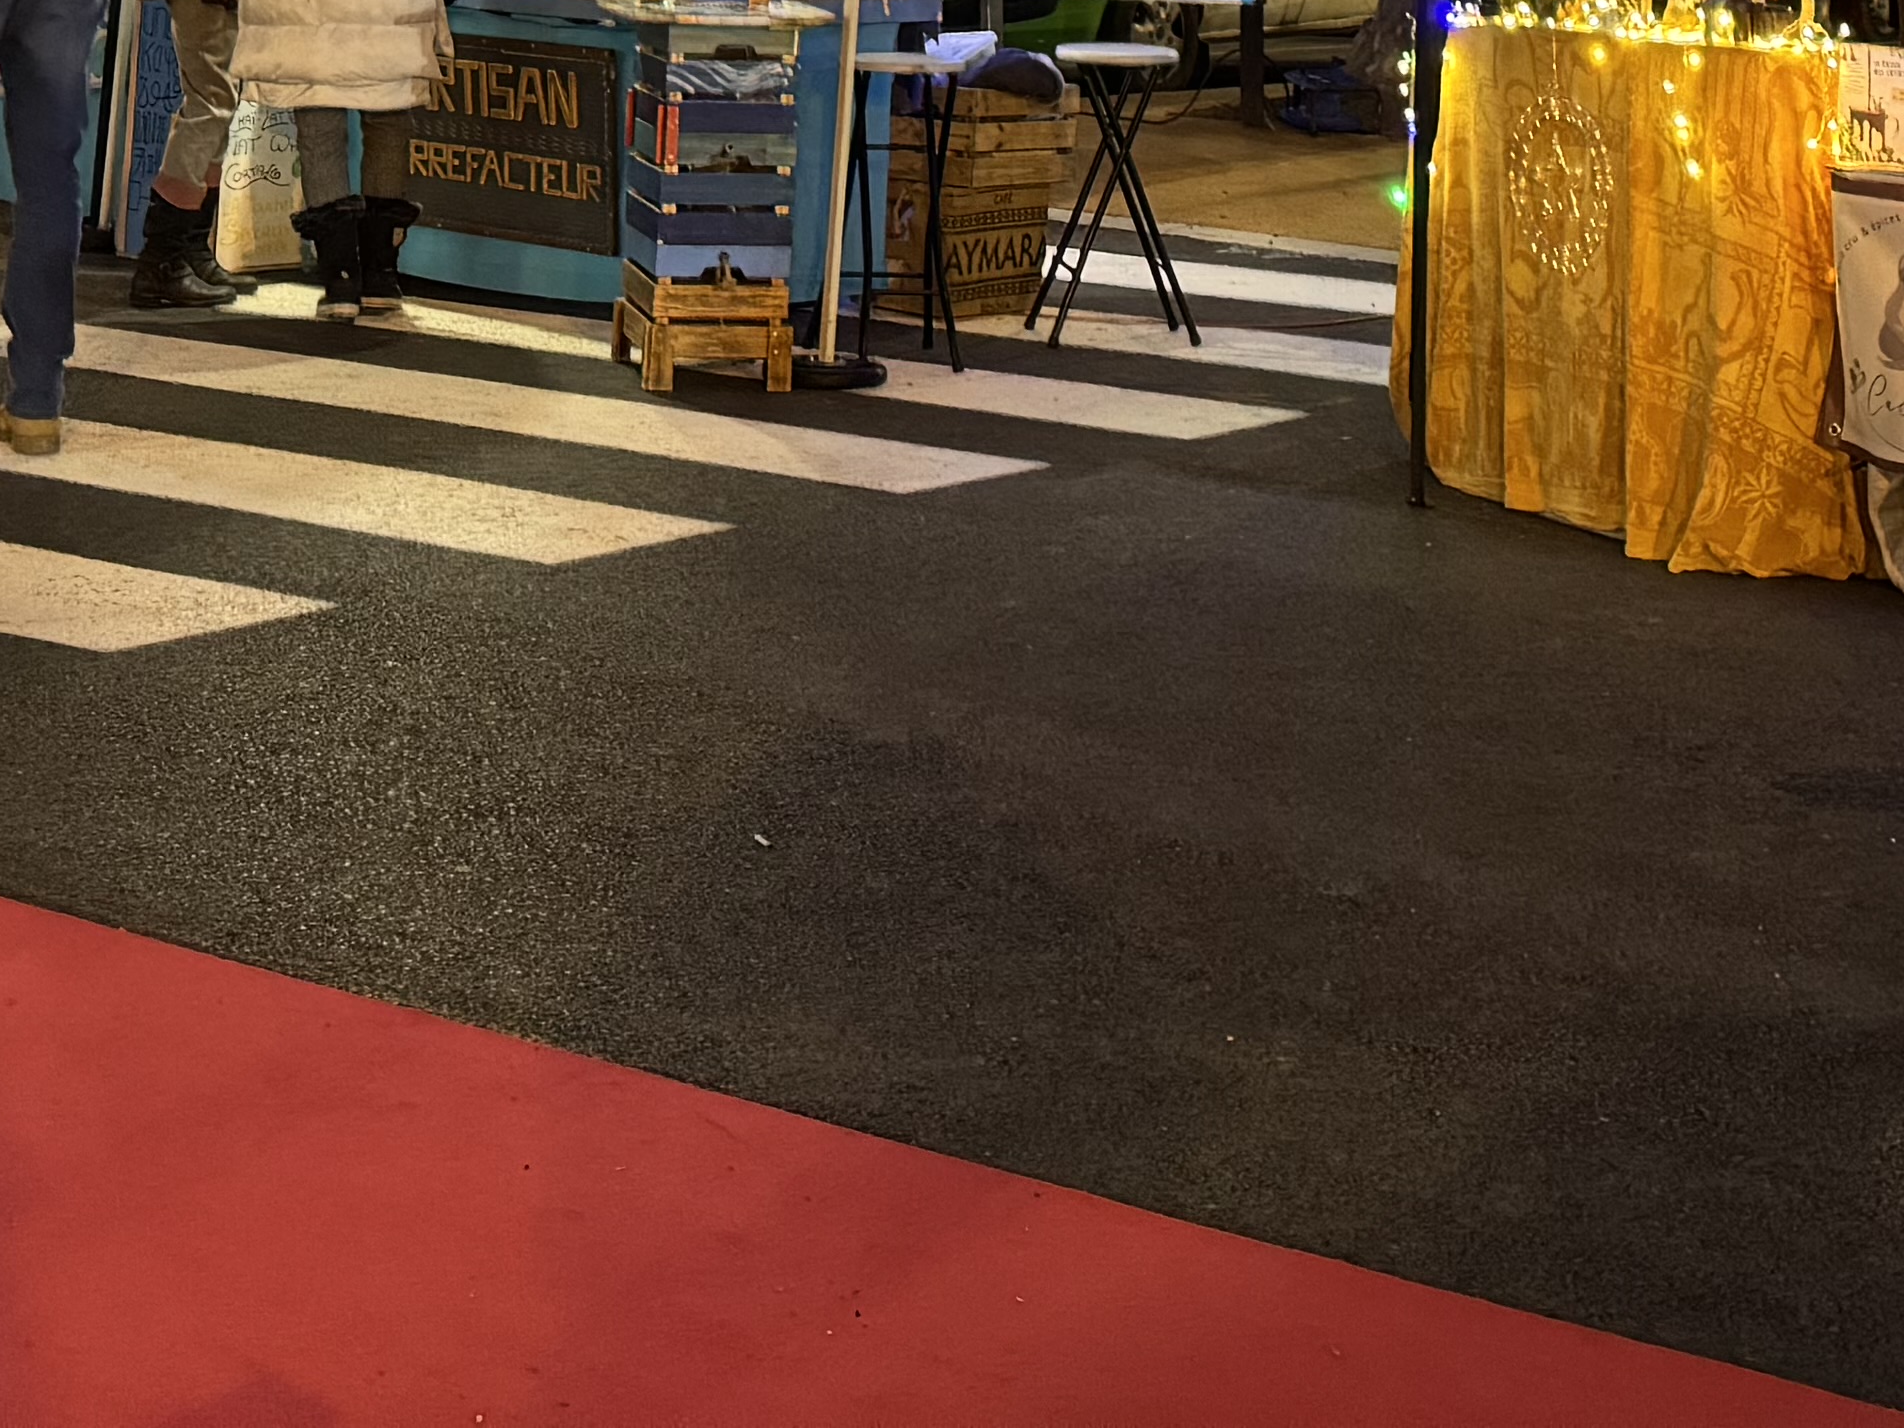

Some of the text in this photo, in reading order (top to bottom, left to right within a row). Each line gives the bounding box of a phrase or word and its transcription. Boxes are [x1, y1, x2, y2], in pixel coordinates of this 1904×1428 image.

[426, 57, 579, 128] RTISAN
[409, 139, 601, 202] RREFACTEUR
[945, 231, 1046, 276] AYMARA
